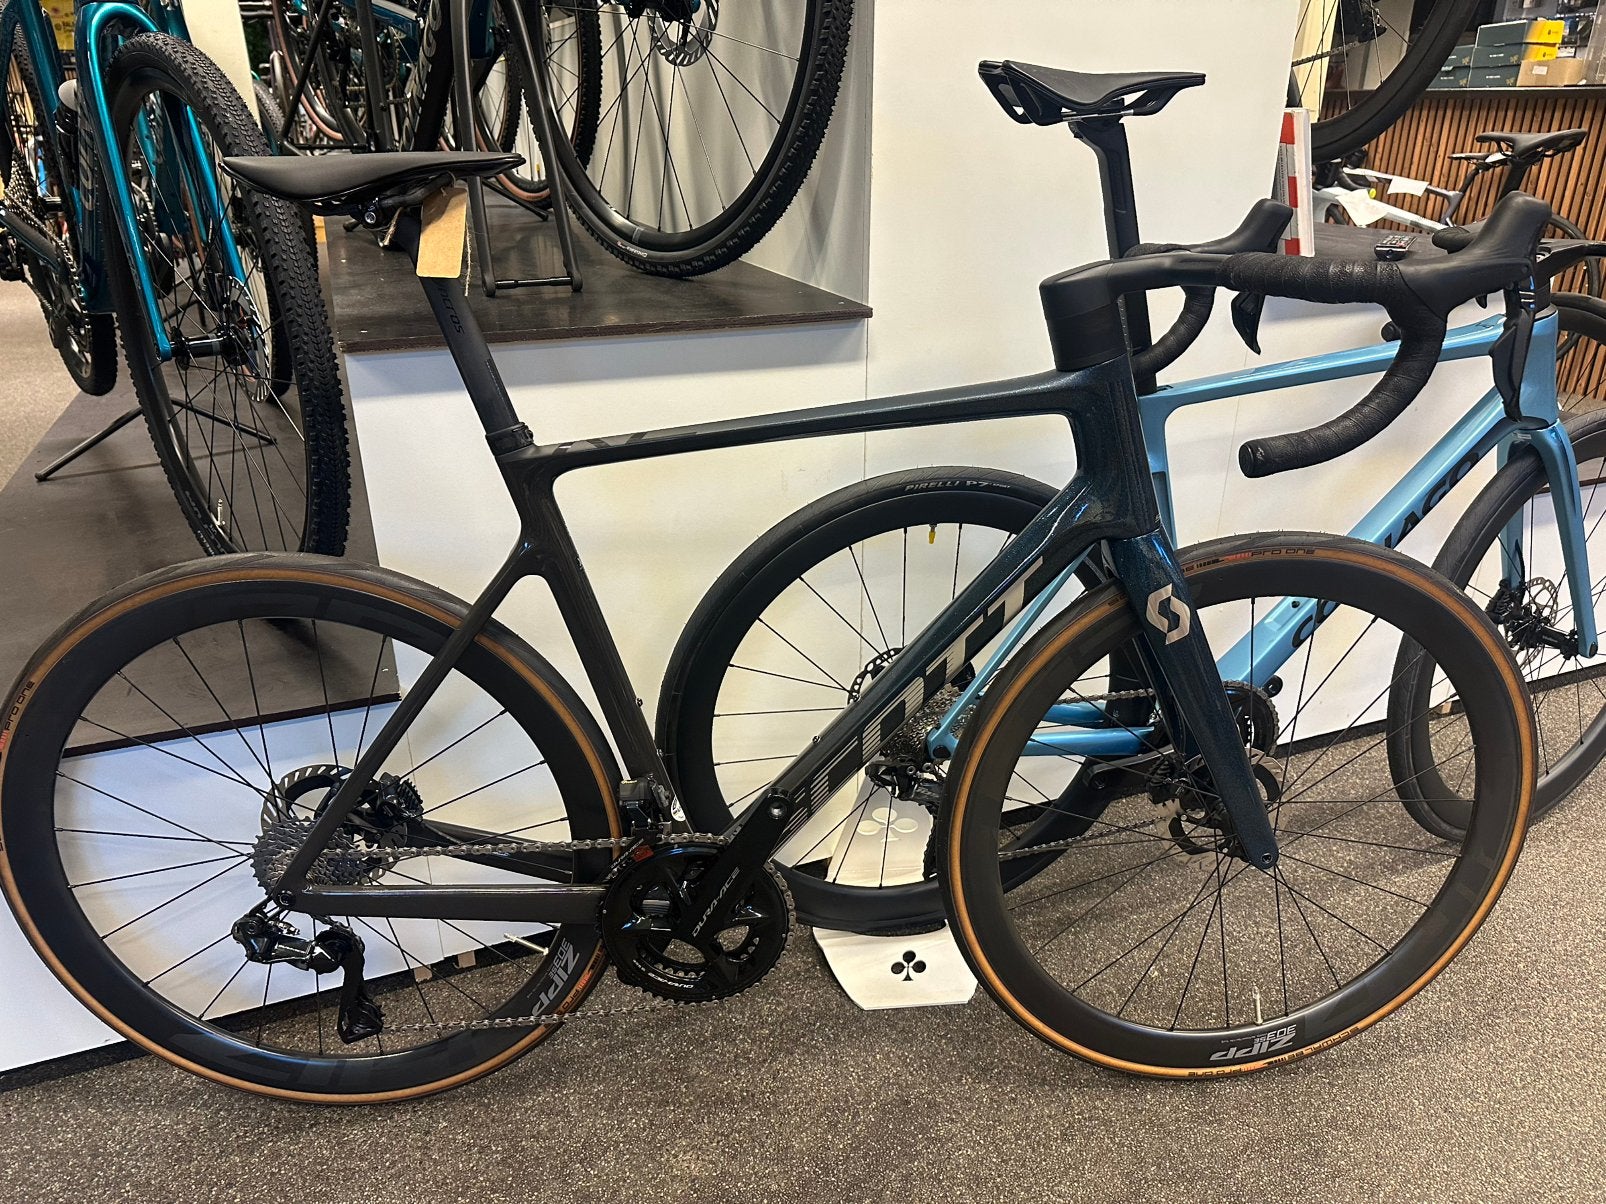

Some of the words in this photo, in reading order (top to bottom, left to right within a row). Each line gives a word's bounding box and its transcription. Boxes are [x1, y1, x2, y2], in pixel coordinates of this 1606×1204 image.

[904, 480, 960, 492] PIRELLI
[777, 556, 1043, 848] SCOTT
[691, 866, 740, 937] DURA-ACE
[531, 944, 580, 1017] ZIPP
[1209, 1032, 1297, 1061] ZIPP
[1285, 1026, 1360, 1061] SCHWALBE
